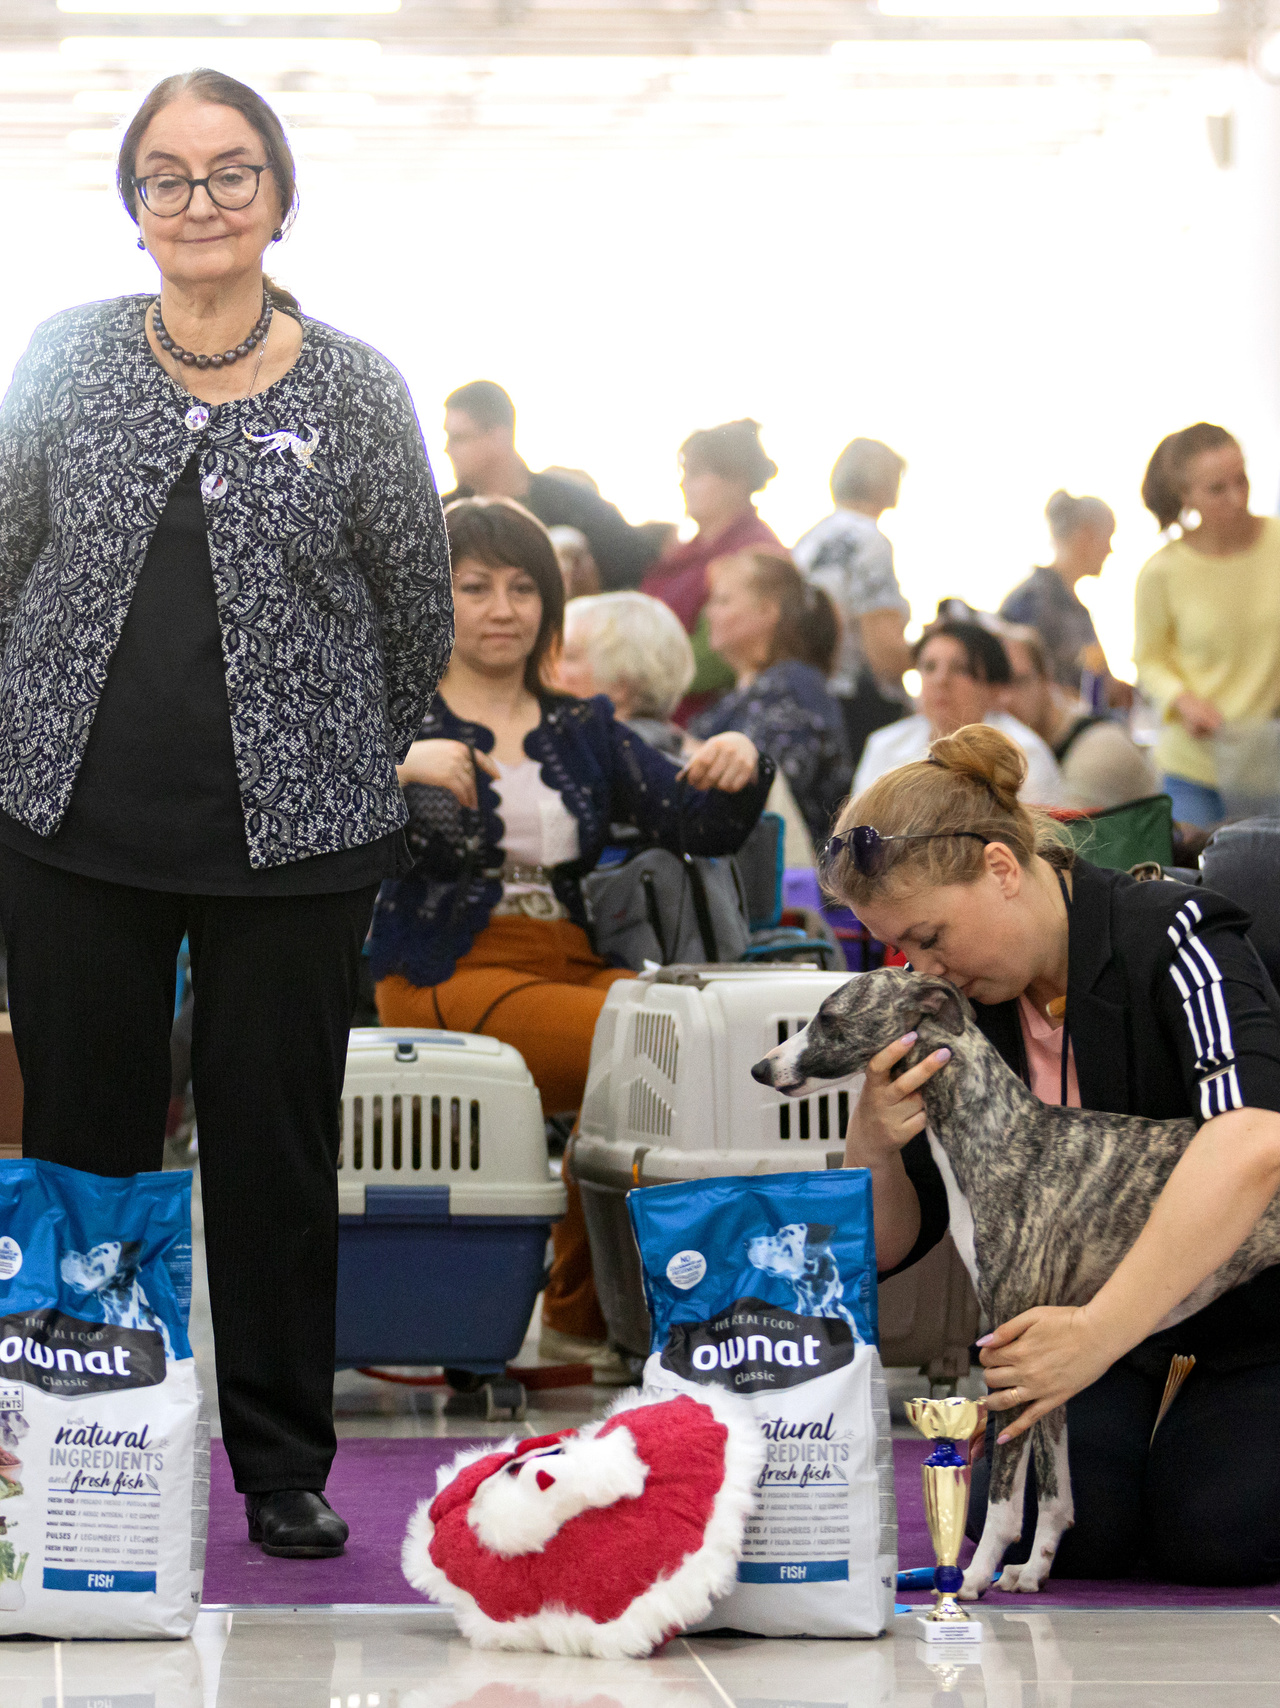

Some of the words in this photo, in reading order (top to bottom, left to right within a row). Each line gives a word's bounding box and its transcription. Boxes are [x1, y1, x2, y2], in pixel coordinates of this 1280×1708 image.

[731, 1314, 760, 1325] REAL
[763, 1316, 795, 1331] FOOD
[70, 1331, 104, 1341] FOOD
[692, 1334, 821, 1371] ownat
[54, 1421, 153, 1450] natural
[761, 1412, 836, 1442] atural
[49, 1447, 164, 1472] INGREDIENTS
[766, 1443, 850, 1462] REDIENTS
[48, 1471, 71, 1484] and
[69, 1469, 111, 1494] fresh
[111, 1471, 145, 1496] fish
[757, 1464, 798, 1488] fresh
[799, 1464, 832, 1488] fish
[46, 1531, 71, 1540] PULSES
[87, 1573, 115, 1588] FISH
[780, 1565, 807, 1579] FISH
